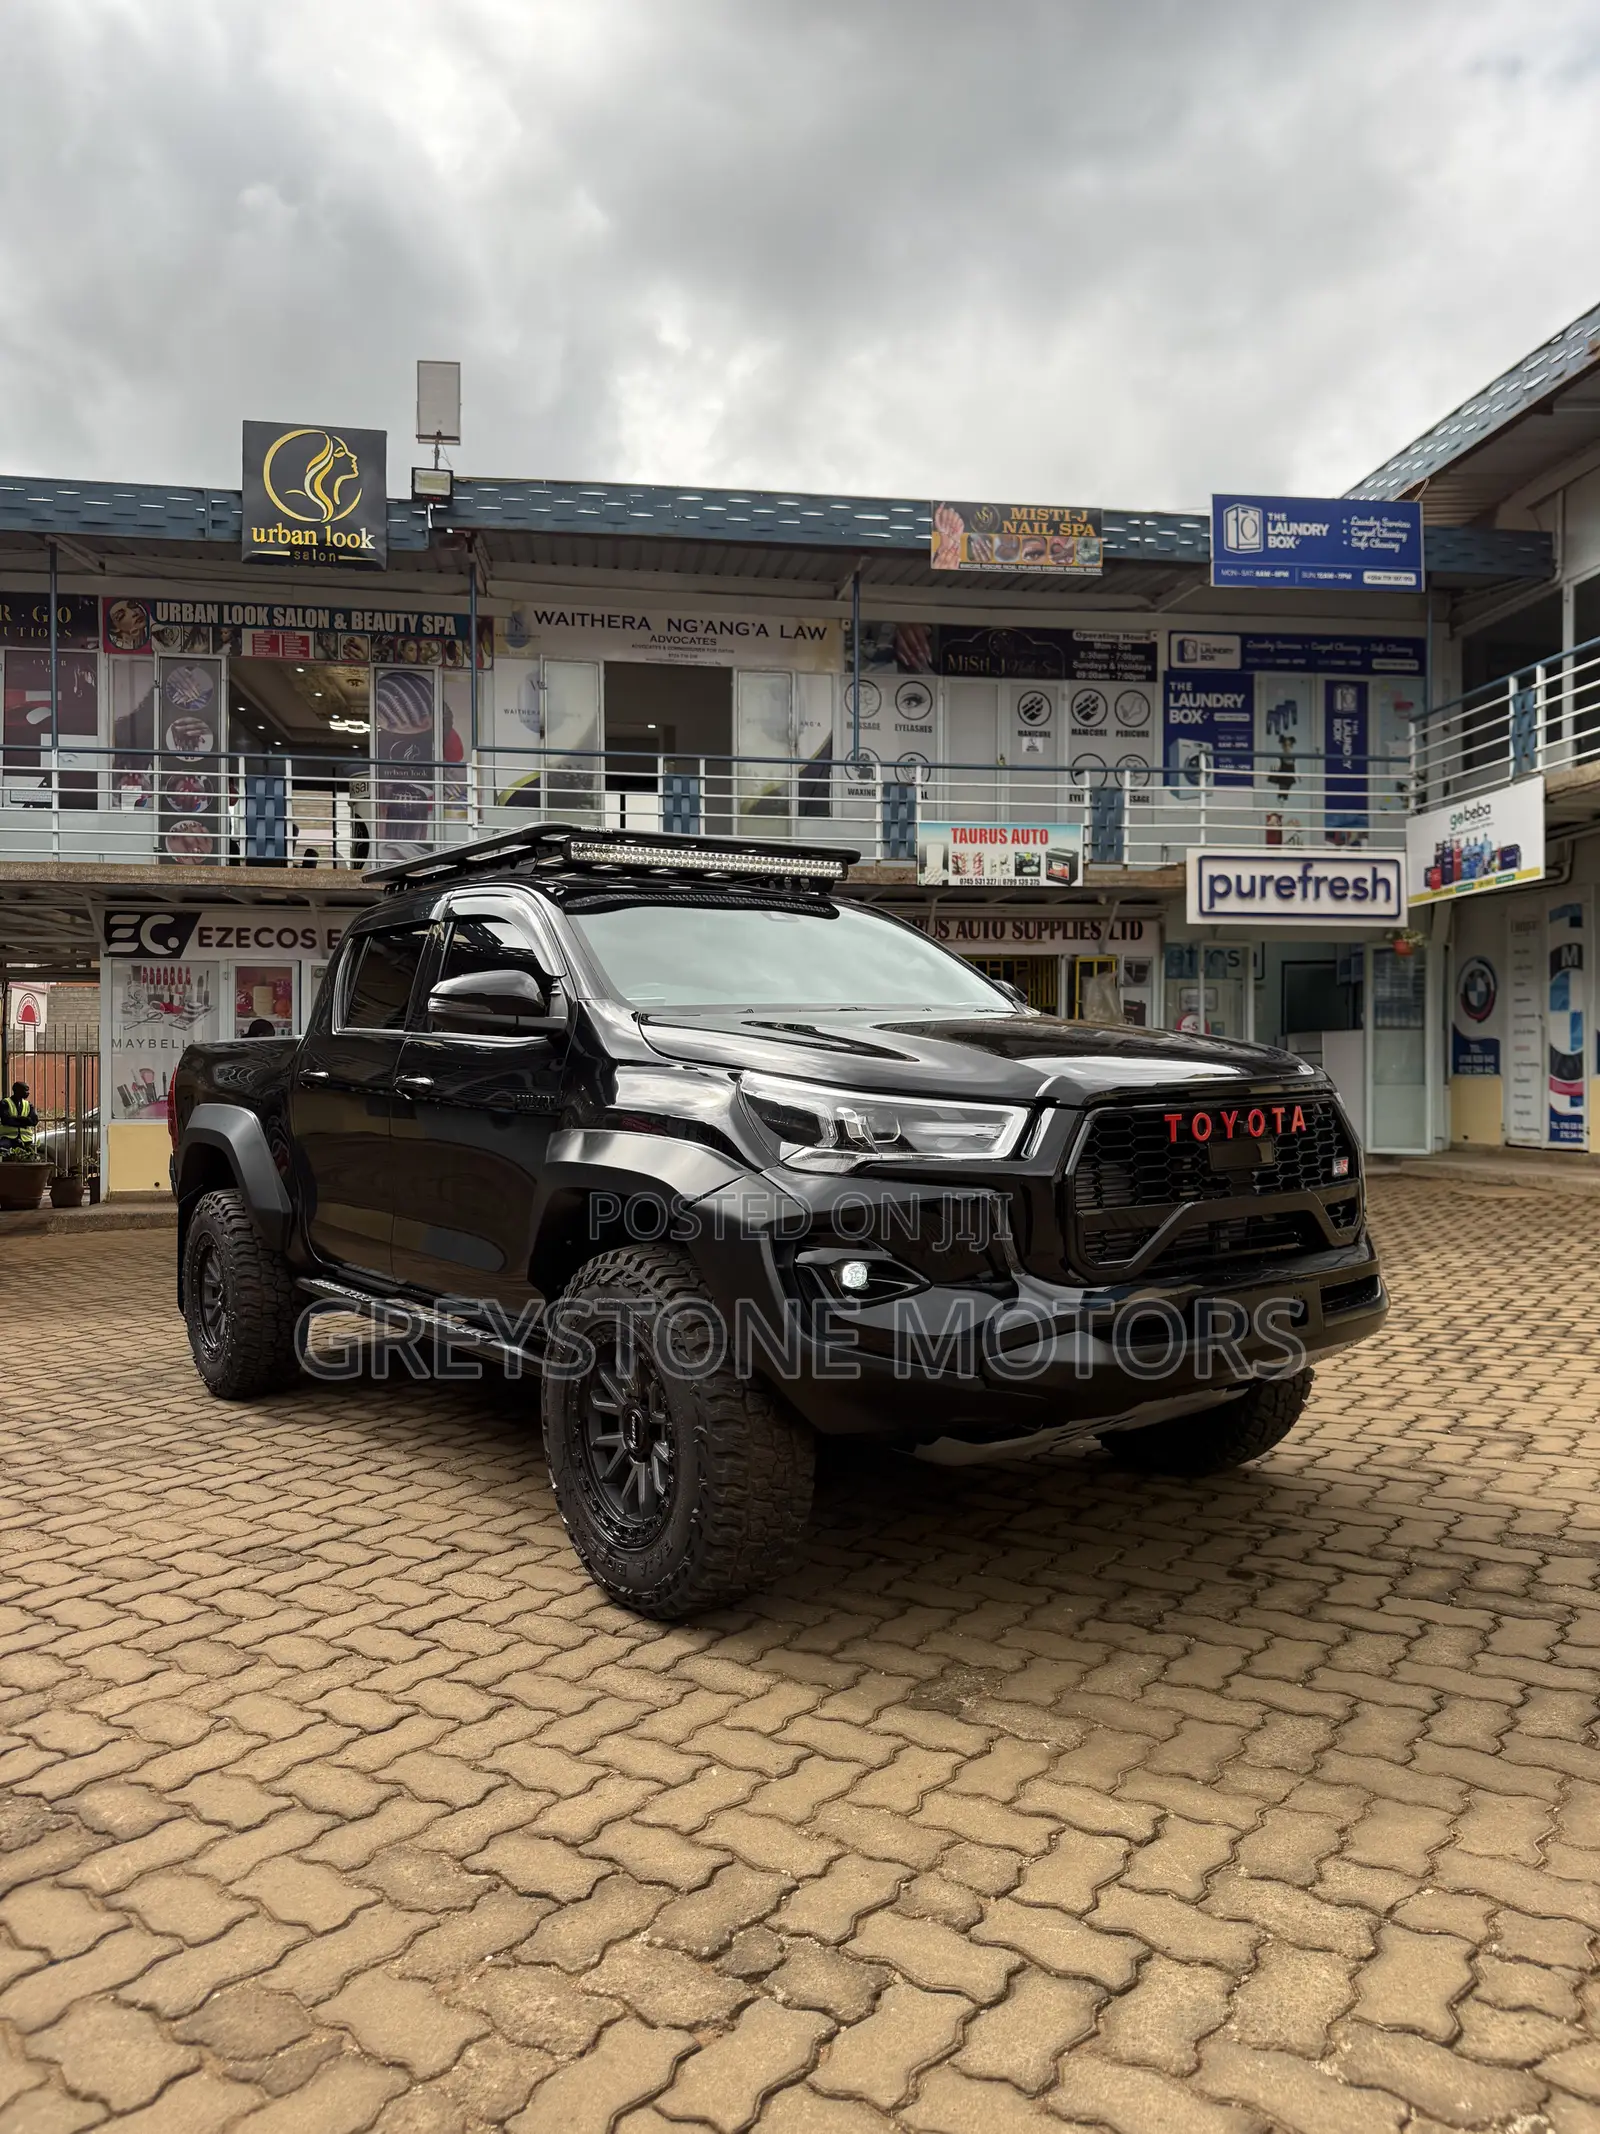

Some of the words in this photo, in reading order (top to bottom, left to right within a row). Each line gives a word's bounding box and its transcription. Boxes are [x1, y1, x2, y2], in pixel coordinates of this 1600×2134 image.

[1010, 507, 1088, 522] MISTI-J
[1267, 512, 1287, 521] THE
[251, 522, 319, 545] urban
[325, 525, 376, 549] look
[1002, 520, 1054, 535] NAIL
[1059, 523, 1096, 537] SPA
[1267, 522, 1330, 536] LAUNDRY
[1268, 536, 1296, 549] BOX
[293, 549, 336, 562] salon
[156, 602, 218, 624] URBAN
[223, 605, 270, 626] LOOK
[273, 607, 330, 629] SALON
[334, 613, 348, 630] &
[351, 611, 419, 634] BEAUTY
[422, 615, 456, 635] SPA
[534, 610, 652, 631] WAITHERA
[780, 625, 827, 640] LAW
[650, 634, 717, 646] ADVOCATES
[1169, 682, 1193, 691] THE
[1169, 693, 1246, 708] LAUNDRY
[1169, 709, 1204, 724] BOX
[846, 721, 881, 731] MSSAGE
[895, 723, 933, 733] EYELASHES
[1071, 728, 1108, 737] MANICURE
[1017, 730, 1051, 739] MANICURE
[1115, 730, 1150, 738] PEDICURE
[951, 827, 1008, 845] TAURUS
[1010, 829, 1049, 845] AUTO
[1208, 863, 1391, 909] purefresh
[198, 926, 317, 949] EZECOS
[956, 920, 1005, 939] AUTO
[1012, 920, 1101, 940] SUPPLIES
[1107, 920, 1143, 940] LTD
[1164, 1106, 1306, 1143] TOYOTA
